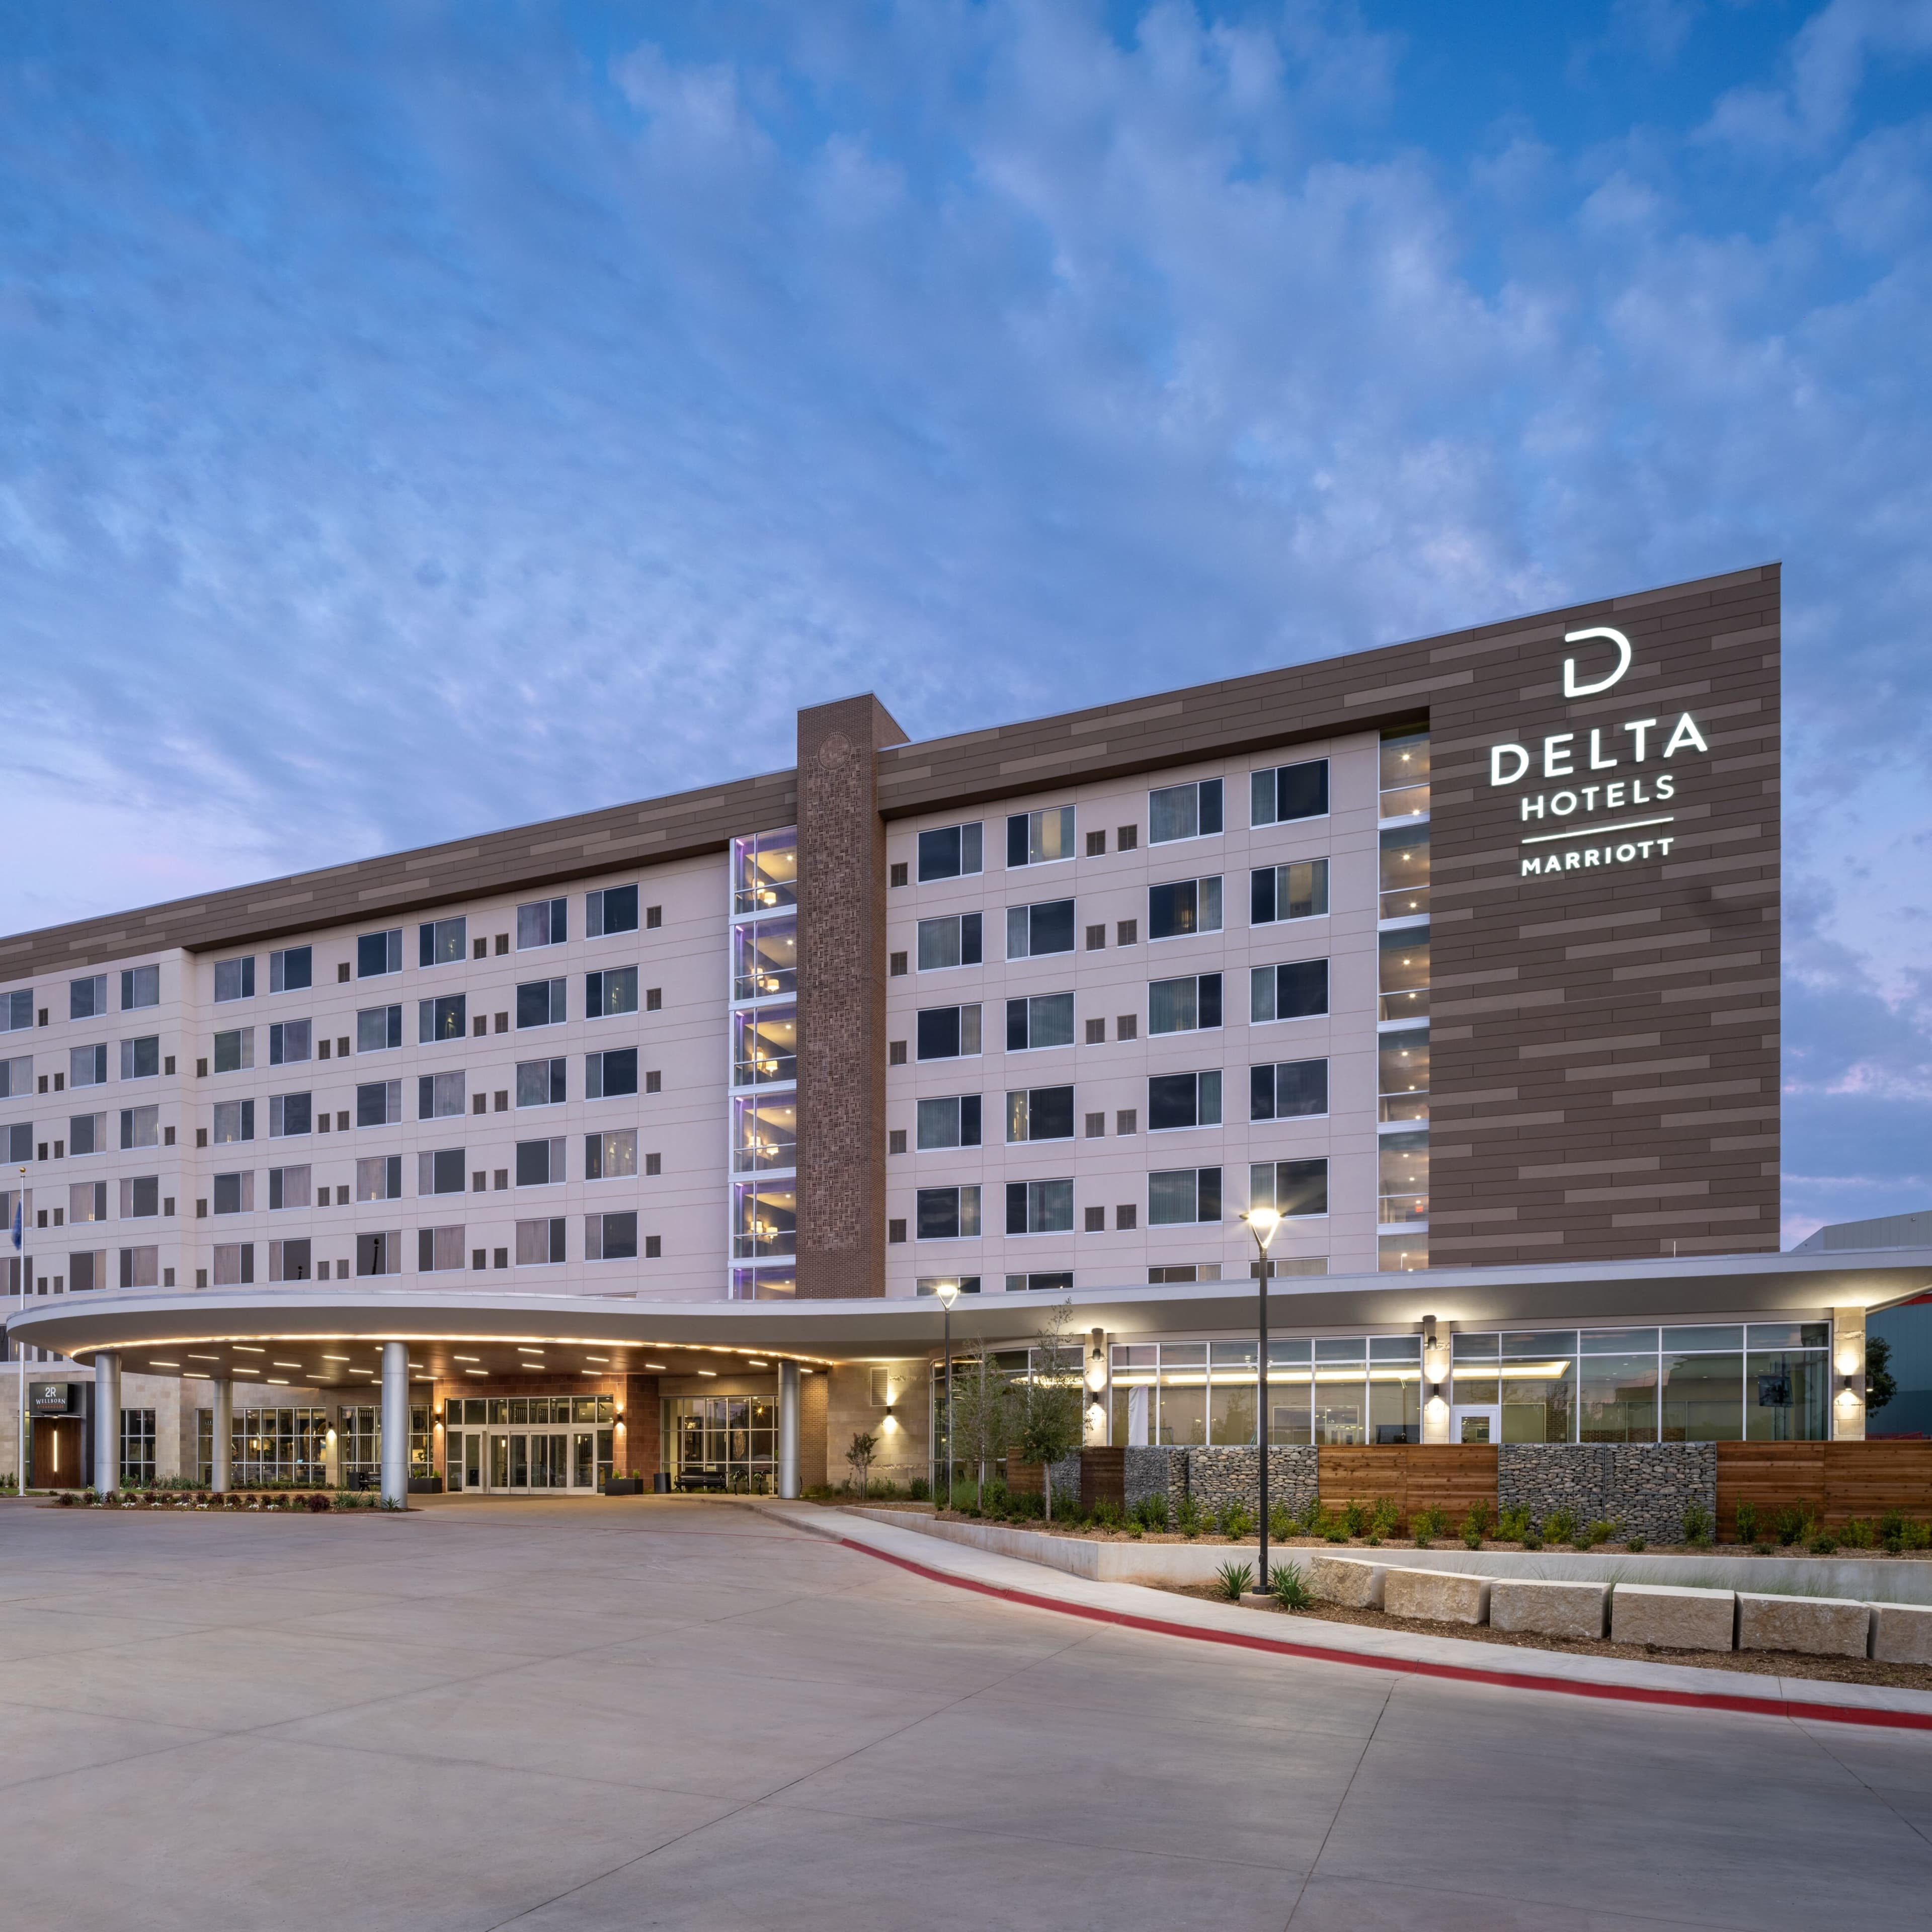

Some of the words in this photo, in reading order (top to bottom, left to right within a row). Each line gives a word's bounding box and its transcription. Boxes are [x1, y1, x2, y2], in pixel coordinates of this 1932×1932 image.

[1491, 712, 1708, 786] DELTA
[1522, 775, 1674, 821] HOTELS
[1521, 838, 1674, 876] MARRIOTT
[45, 1387, 56, 1397] 2R
